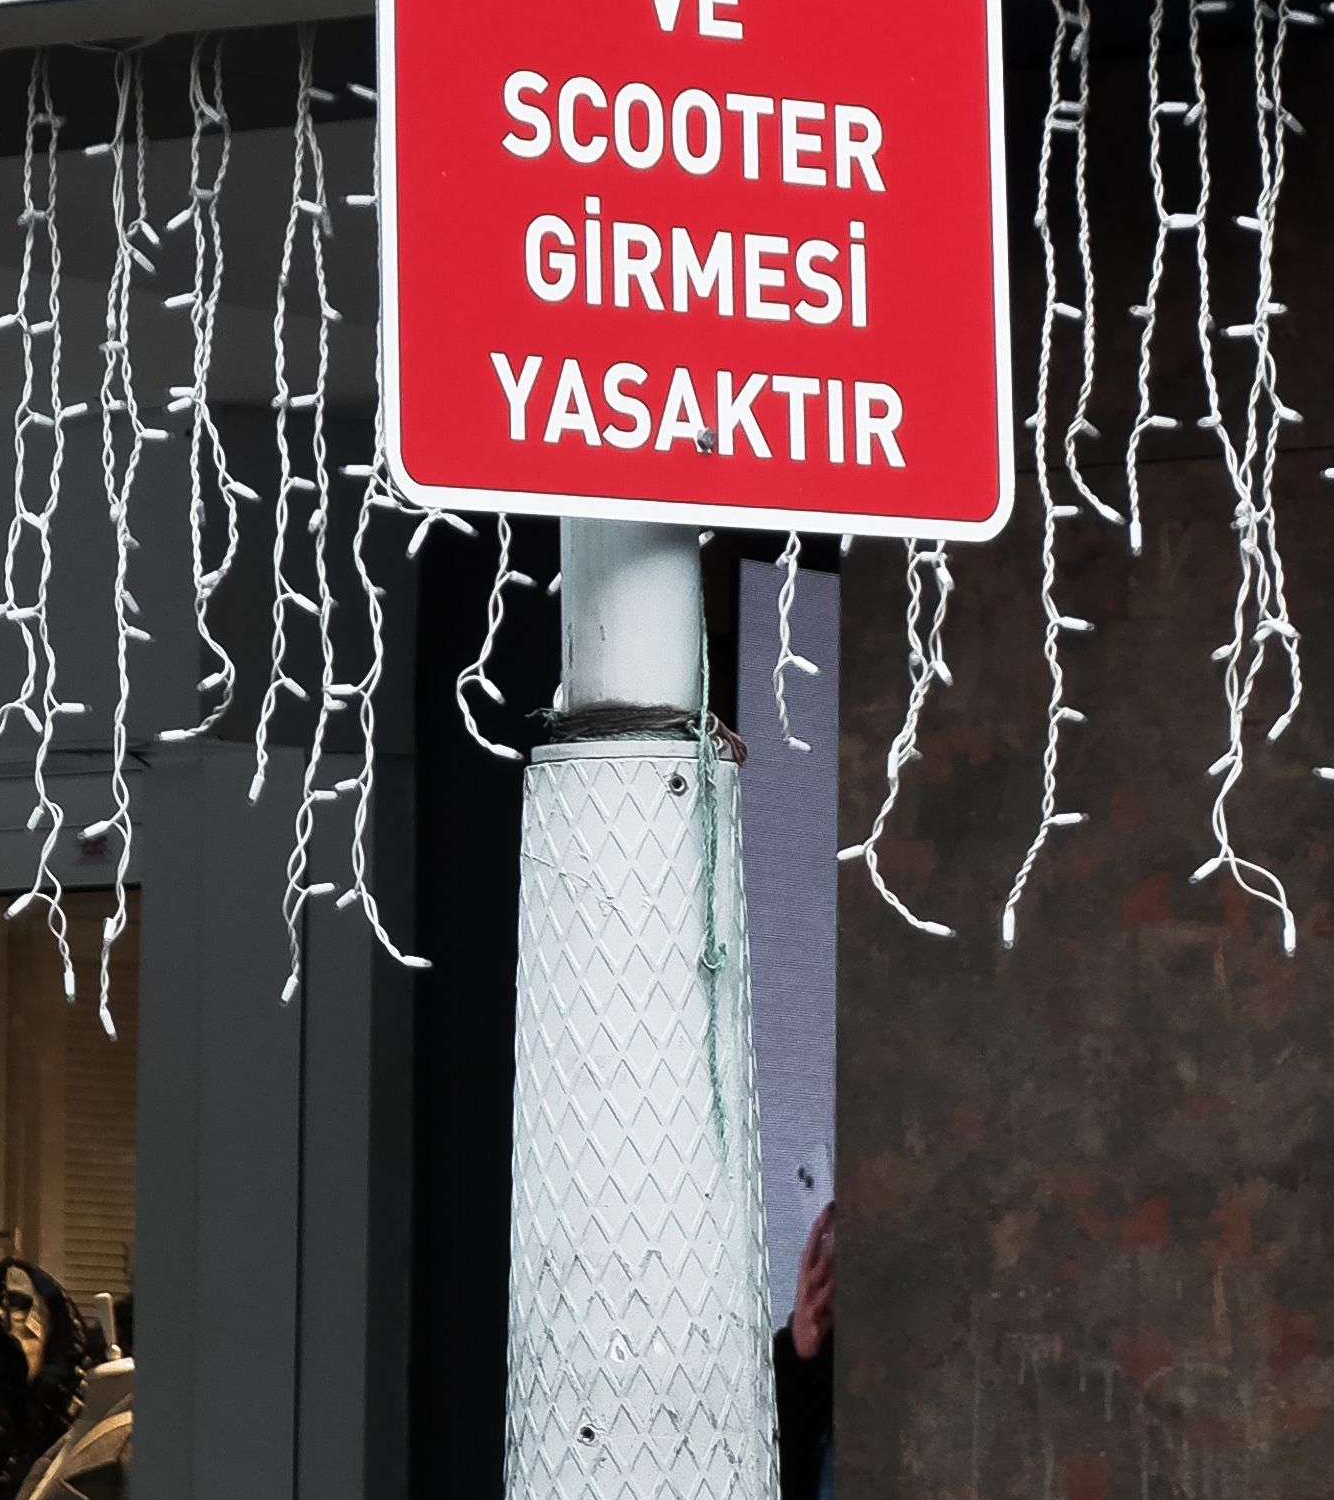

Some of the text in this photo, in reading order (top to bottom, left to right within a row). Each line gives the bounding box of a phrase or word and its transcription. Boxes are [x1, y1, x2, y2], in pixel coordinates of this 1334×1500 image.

[501, 70, 886, 192] SCOOTER
[525, 195, 867, 328] GİRMESİ
[490, 352, 907, 468] YASAKTIR
